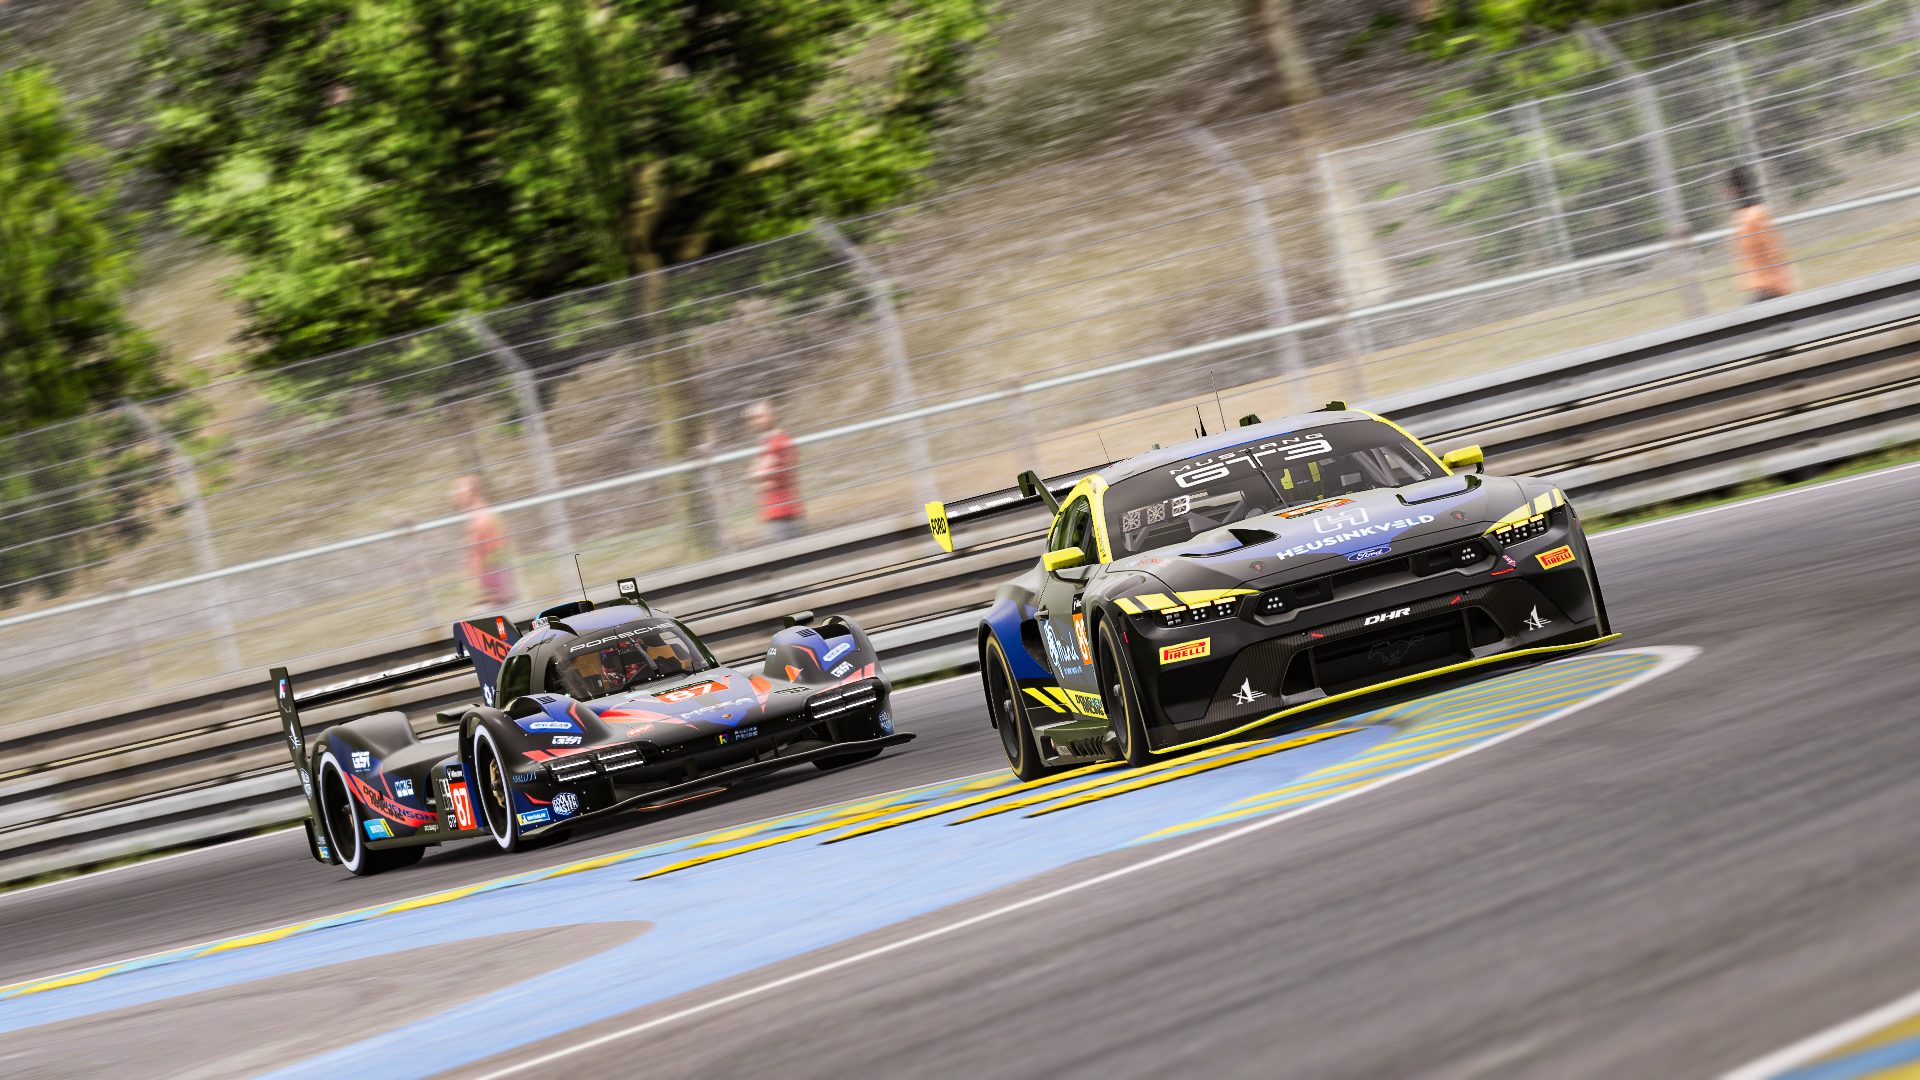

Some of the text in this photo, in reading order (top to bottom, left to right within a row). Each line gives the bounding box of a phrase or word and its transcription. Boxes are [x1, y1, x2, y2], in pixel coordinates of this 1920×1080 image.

[1169, 433, 1324, 475] MUSTANG
[1175, 439, 1333, 488] GT3
[1276, 515, 1434, 560] HEUSINKVELD
[1540, 548, 1572, 567] PIRELLI
[1364, 607, 1411, 626] DHR
[482, 633, 512, 661] MO
[569, 622, 676, 653] PORSCHE
[1163, 641, 1206, 661] PIRELLI
[664, 683, 715, 702] 87
[453, 787, 472, 827] 87
[553, 800, 579, 815] MASTER
